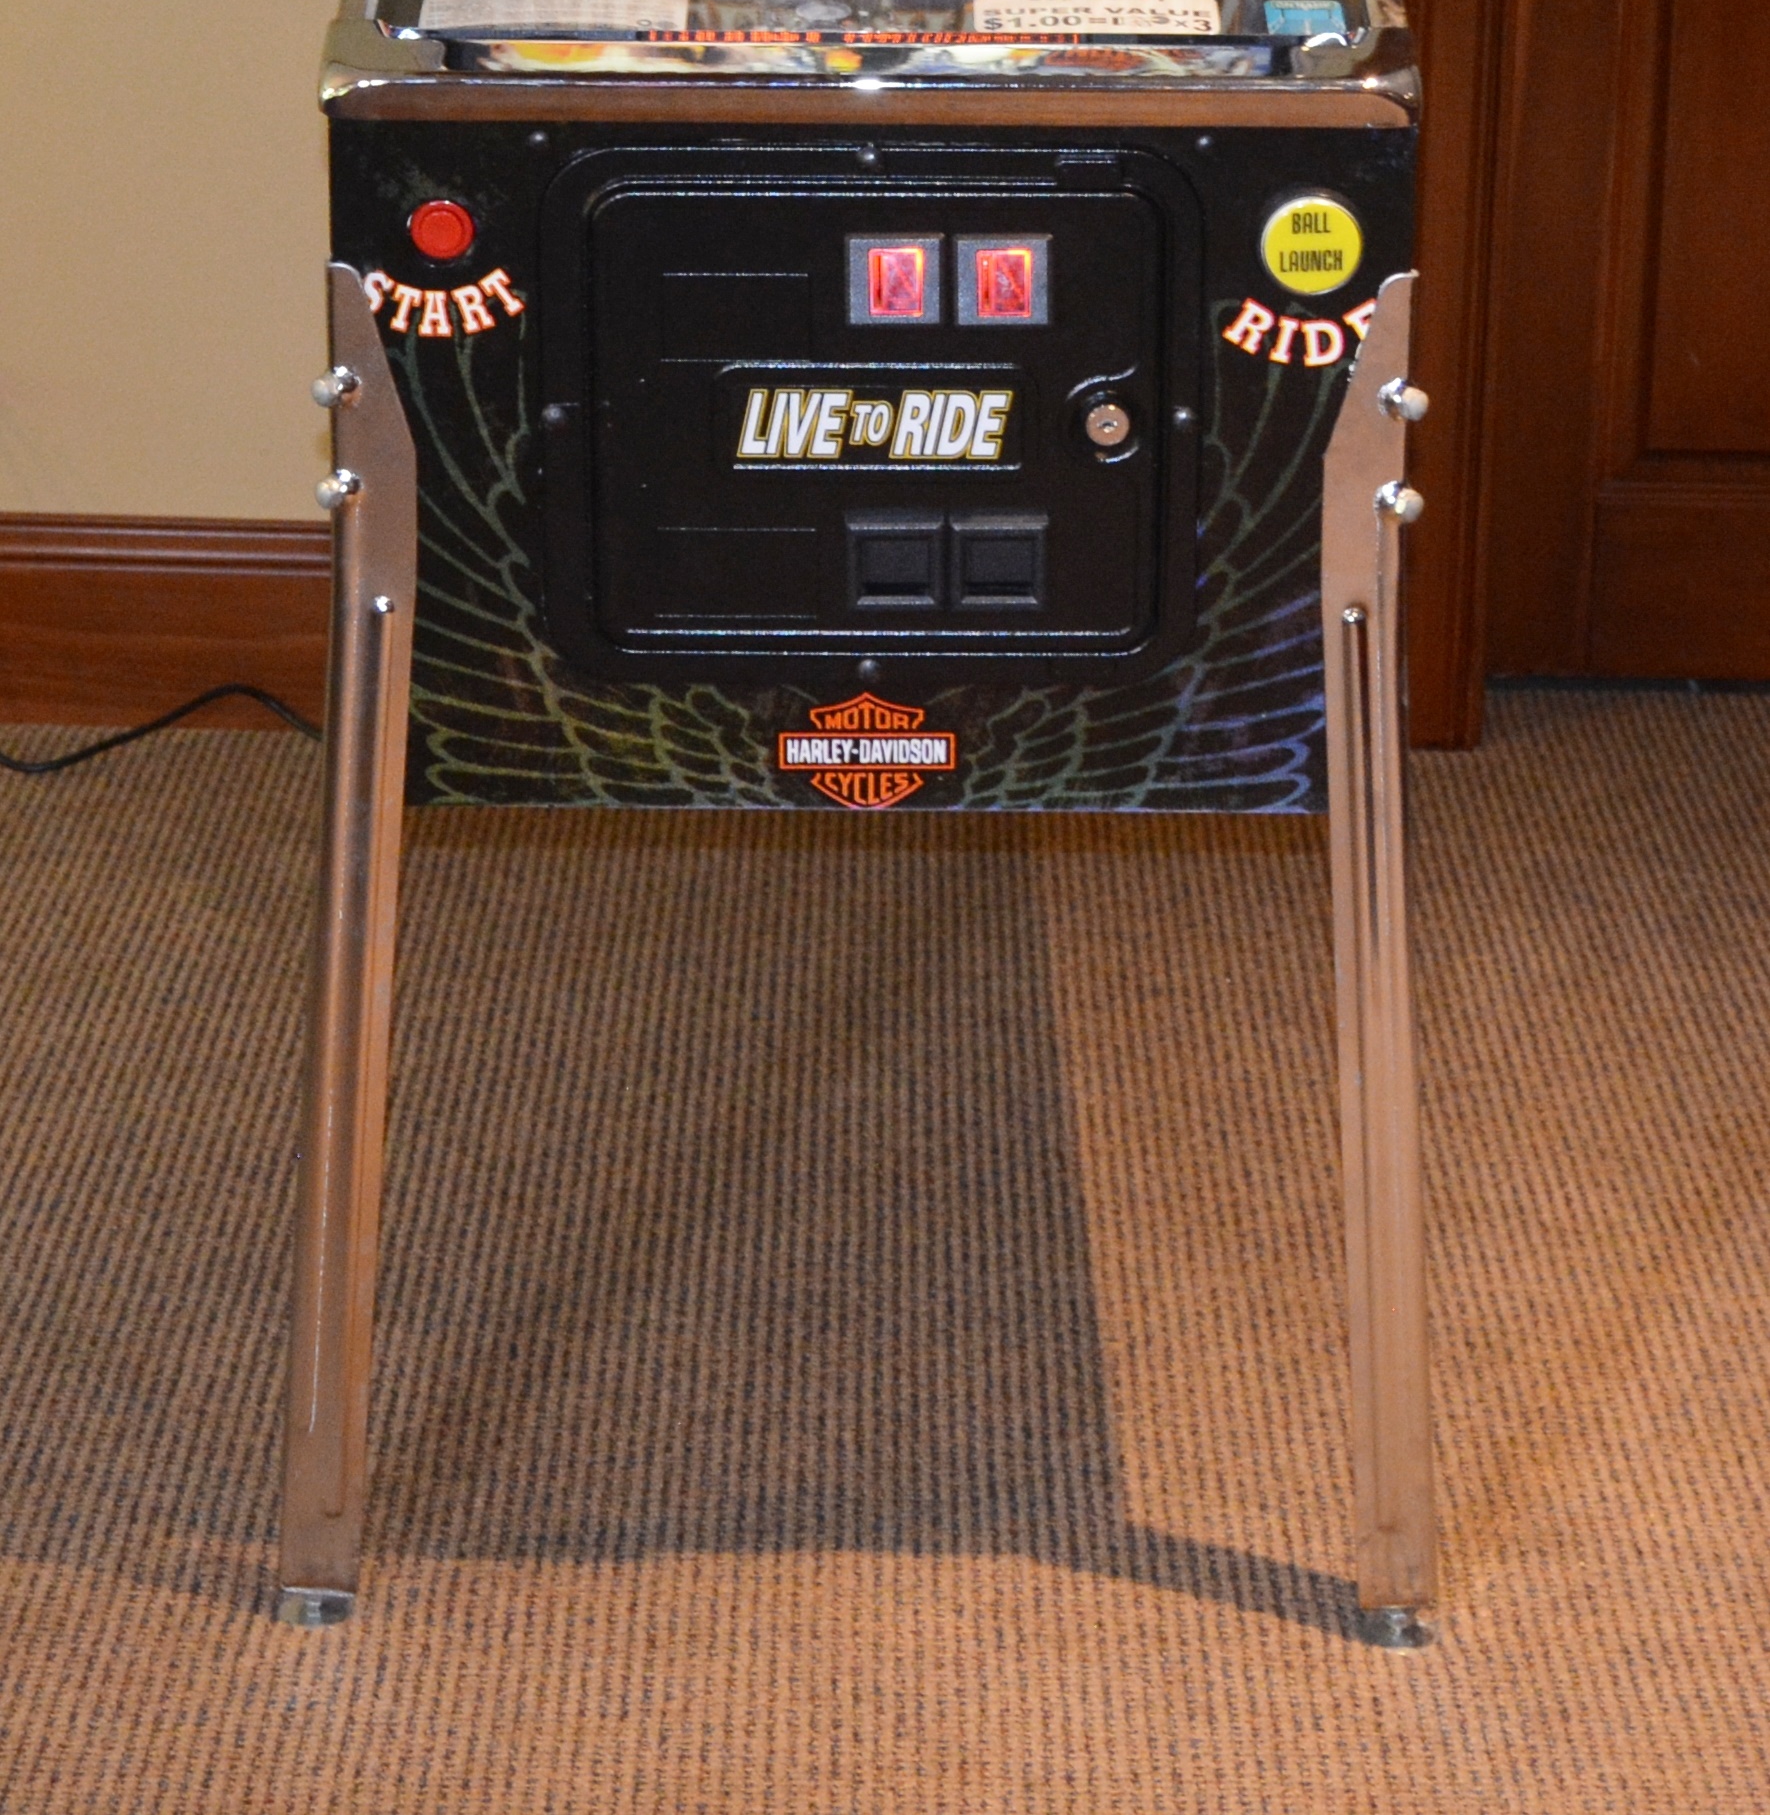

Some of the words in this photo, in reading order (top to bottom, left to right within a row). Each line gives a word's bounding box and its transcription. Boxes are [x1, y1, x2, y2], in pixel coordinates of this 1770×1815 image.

[983, 6, 1093, 17] SUPER
[1103, 6, 1211, 18] VALUE
[1292, 212, 1331, 234] BALL
[1279, 250, 1343, 273] LAUNCH
[364, 267, 526, 337] START
[737, 389, 852, 458] LIVE
[850, 400, 893, 445] TO
[888, 390, 1012, 459] RIDE
[825, 701, 910, 730] MOTOR
[786, 738, 948, 765] HARLEY-DAVIDSON
[824, 772, 910, 806] CYCLES
